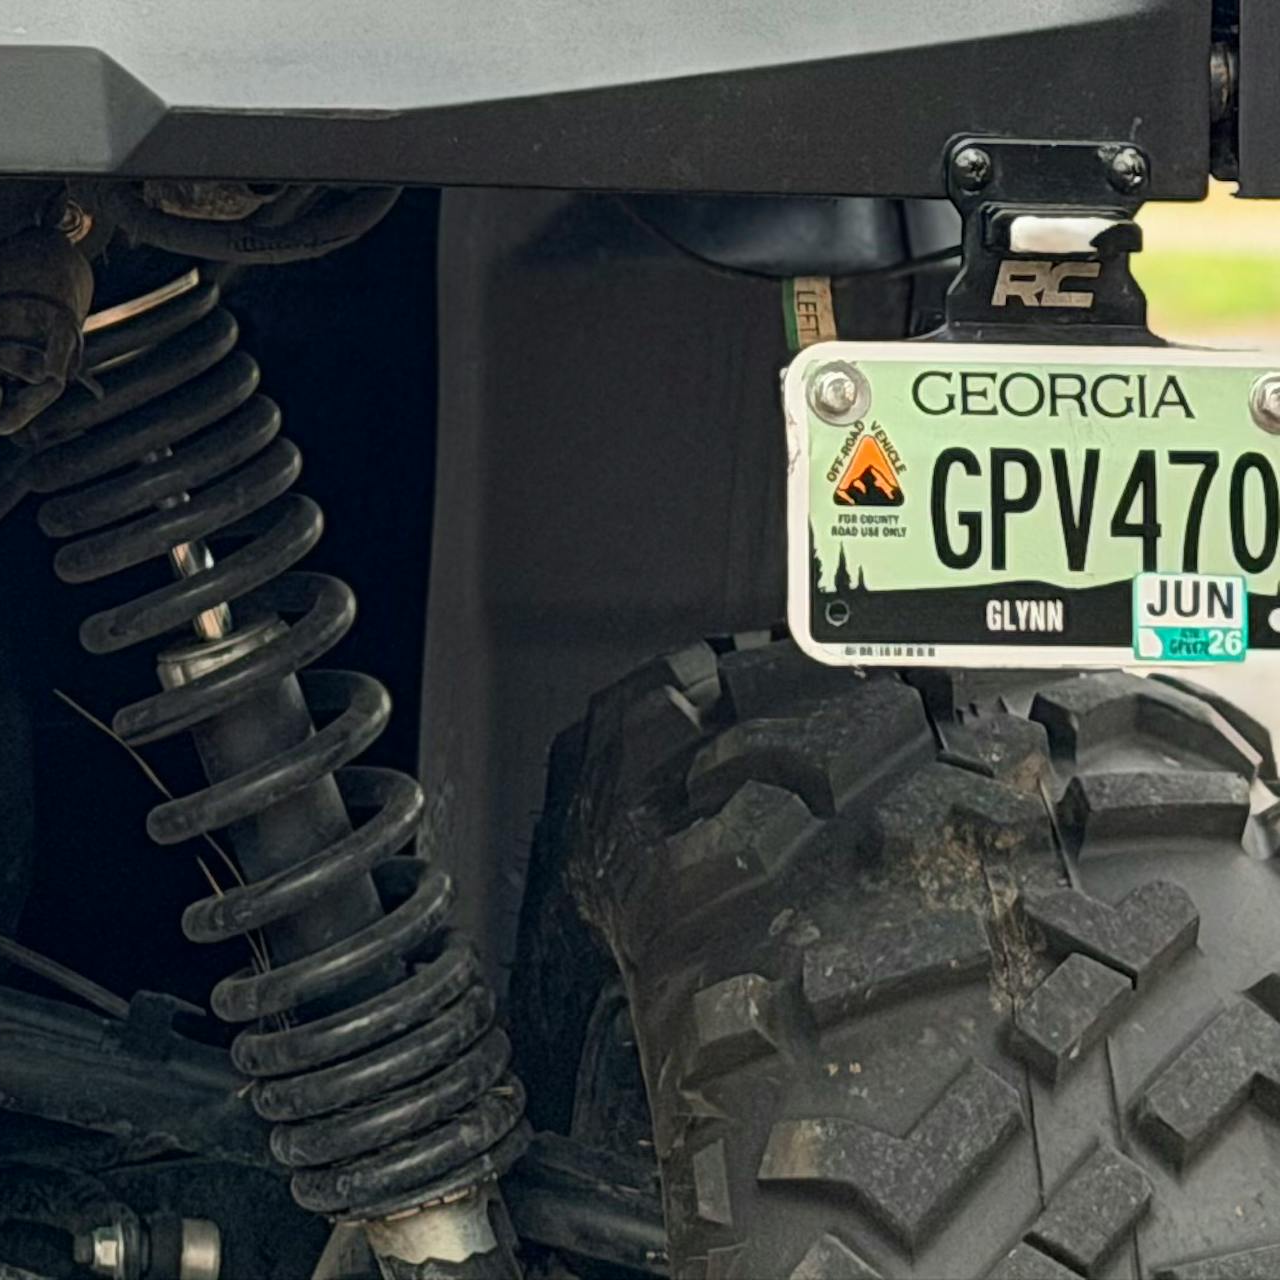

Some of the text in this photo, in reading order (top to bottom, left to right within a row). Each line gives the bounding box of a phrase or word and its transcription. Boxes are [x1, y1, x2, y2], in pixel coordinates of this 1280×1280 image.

[991, 260, 1101, 307] RC
[797, 290, 820, 336] LEFT
[912, 371, 1196, 419] GEORGIA
[826, 420, 907, 483] OFF-ROAD VEHICLE
[931, 446, 1279, 574] GPV470
[986, 600, 1063, 632] GLYNN
[1146, 580, 1233, 619] JUN
[1208, 630, 1242, 655] 26
